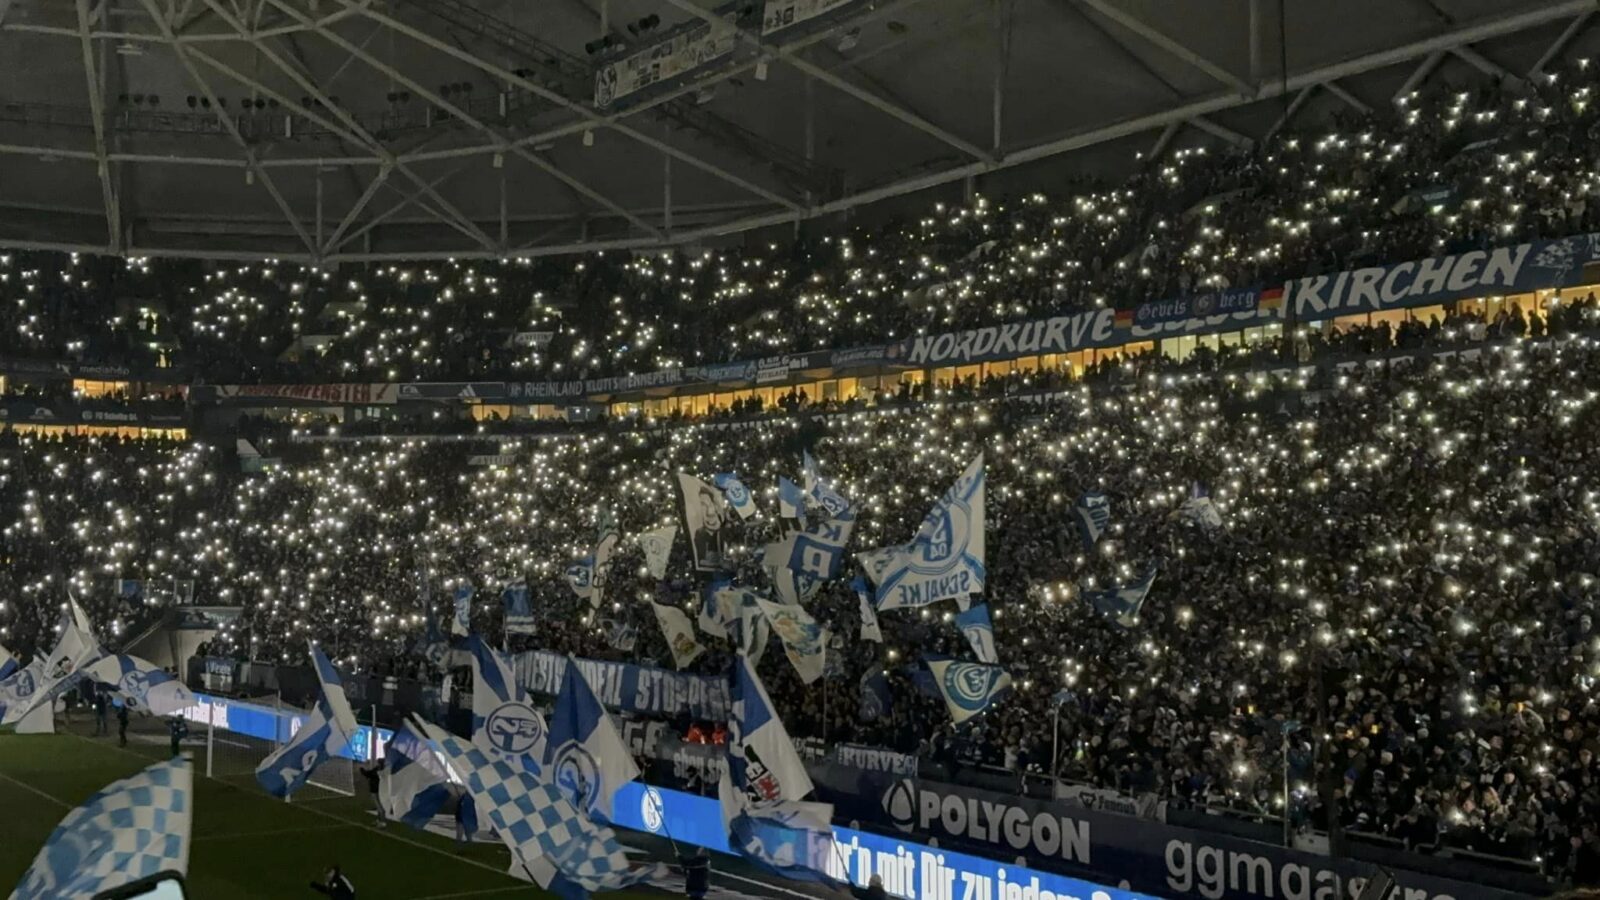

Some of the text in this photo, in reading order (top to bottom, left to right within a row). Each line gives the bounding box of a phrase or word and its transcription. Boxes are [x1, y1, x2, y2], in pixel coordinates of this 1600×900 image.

[1219, 291, 1256, 309] berg
[1296, 244, 1531, 315] KIRCHEN
[908, 308, 1115, 364] NORDKURVE
[525, 381, 583, 397] RHEINLAND
[920, 790, 1090, 865] POLYGON
[877, 845, 915, 899] mit
[921, 851, 956, 900] Dir
[1166, 838, 1457, 900] ggmgas
